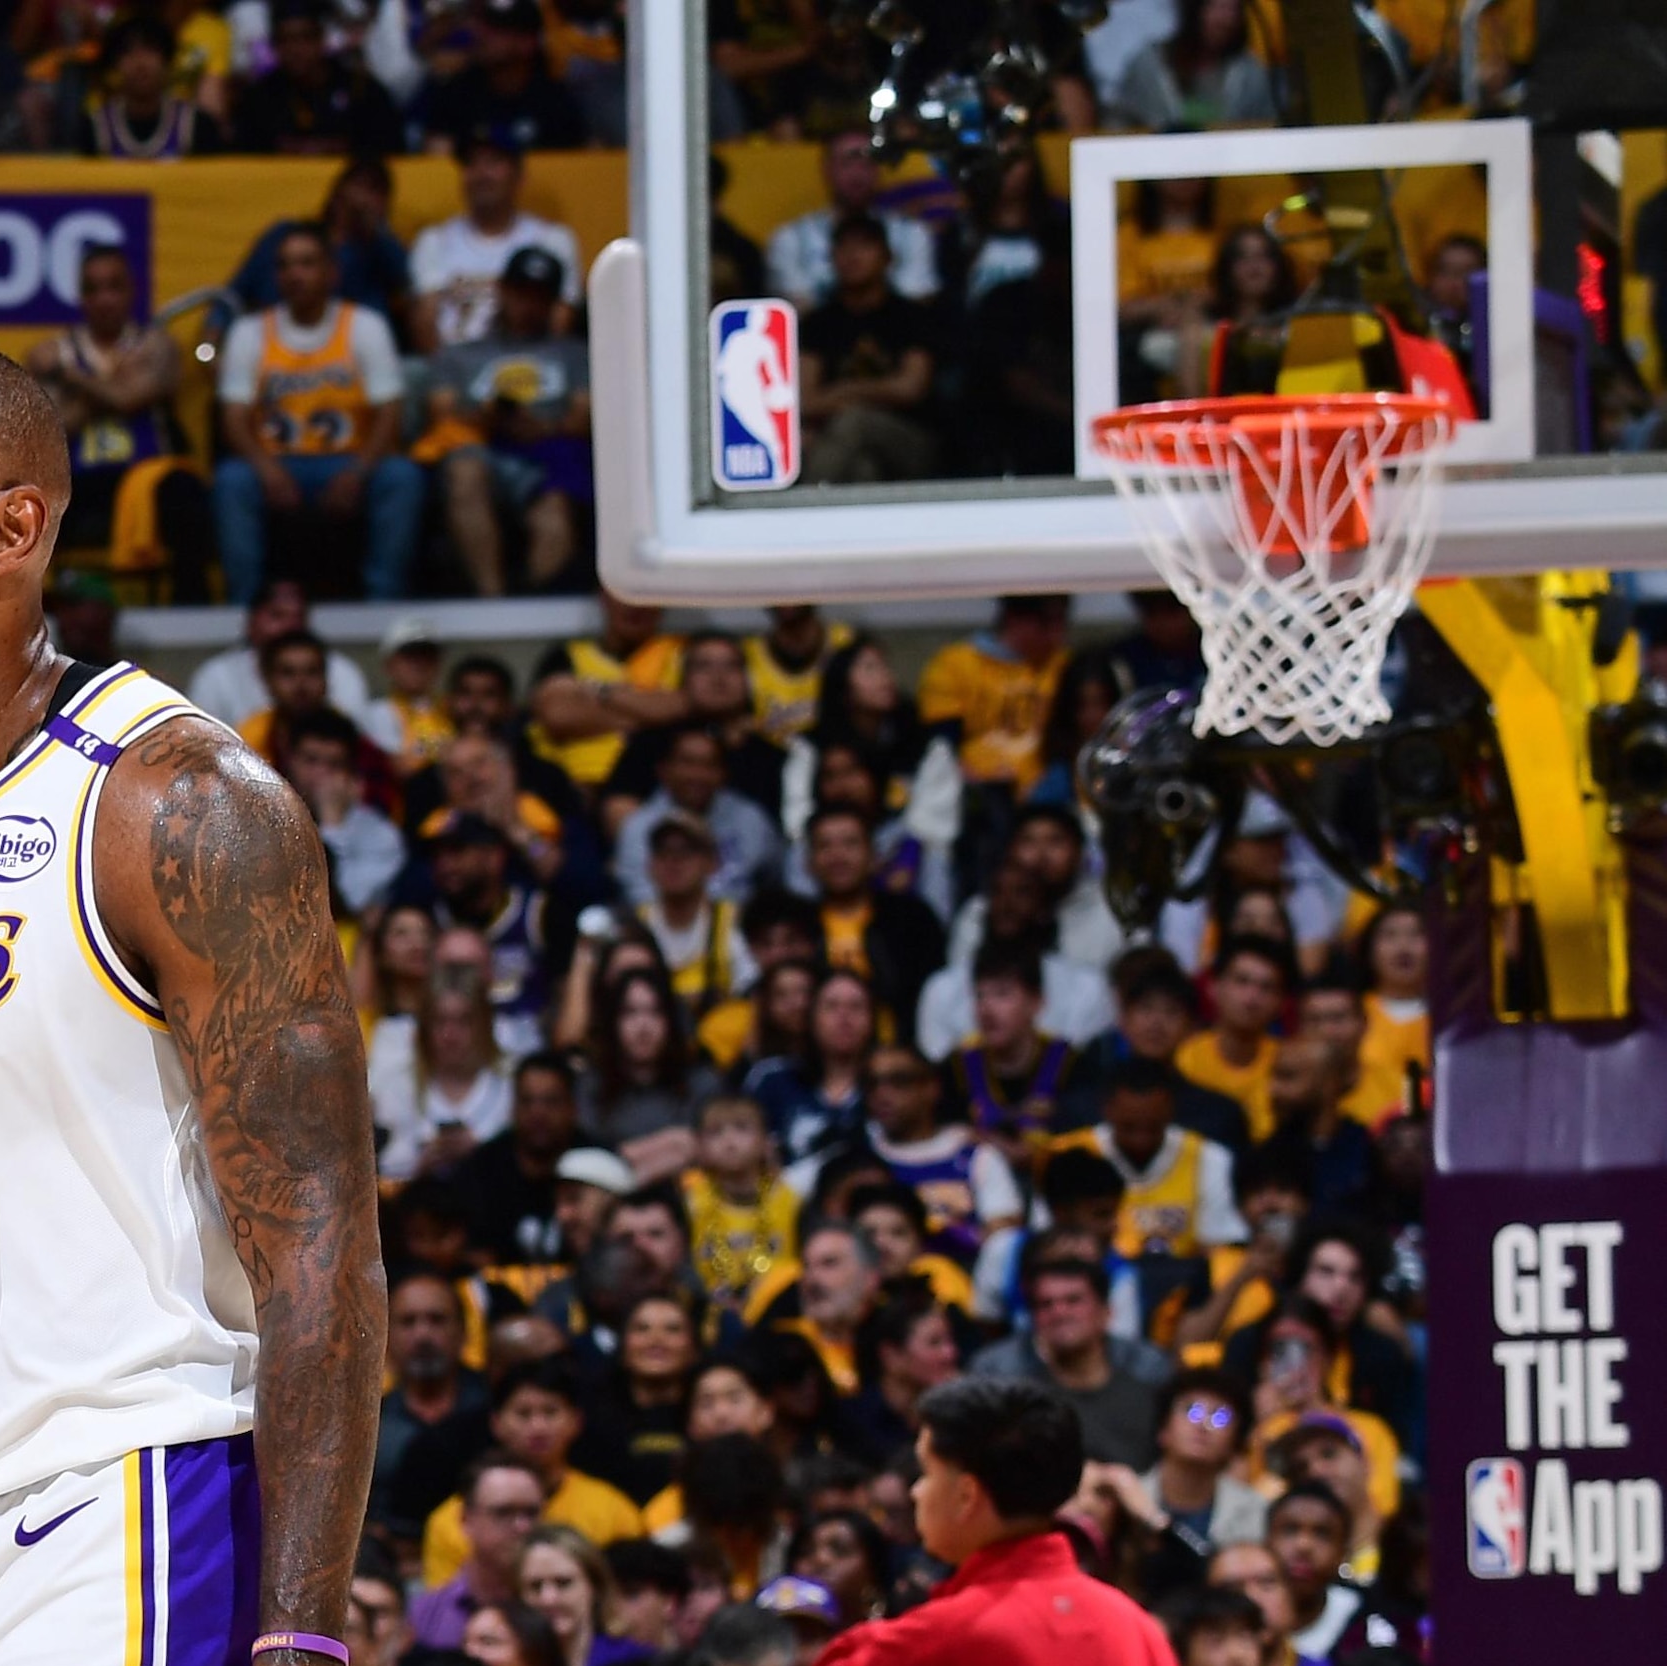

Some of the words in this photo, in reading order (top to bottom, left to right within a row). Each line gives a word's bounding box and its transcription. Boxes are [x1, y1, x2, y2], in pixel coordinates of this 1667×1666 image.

[1492, 1220, 1624, 1336] GET
[1492, 1337, 1630, 1450] THE
[1528, 1457, 1664, 1596] App
